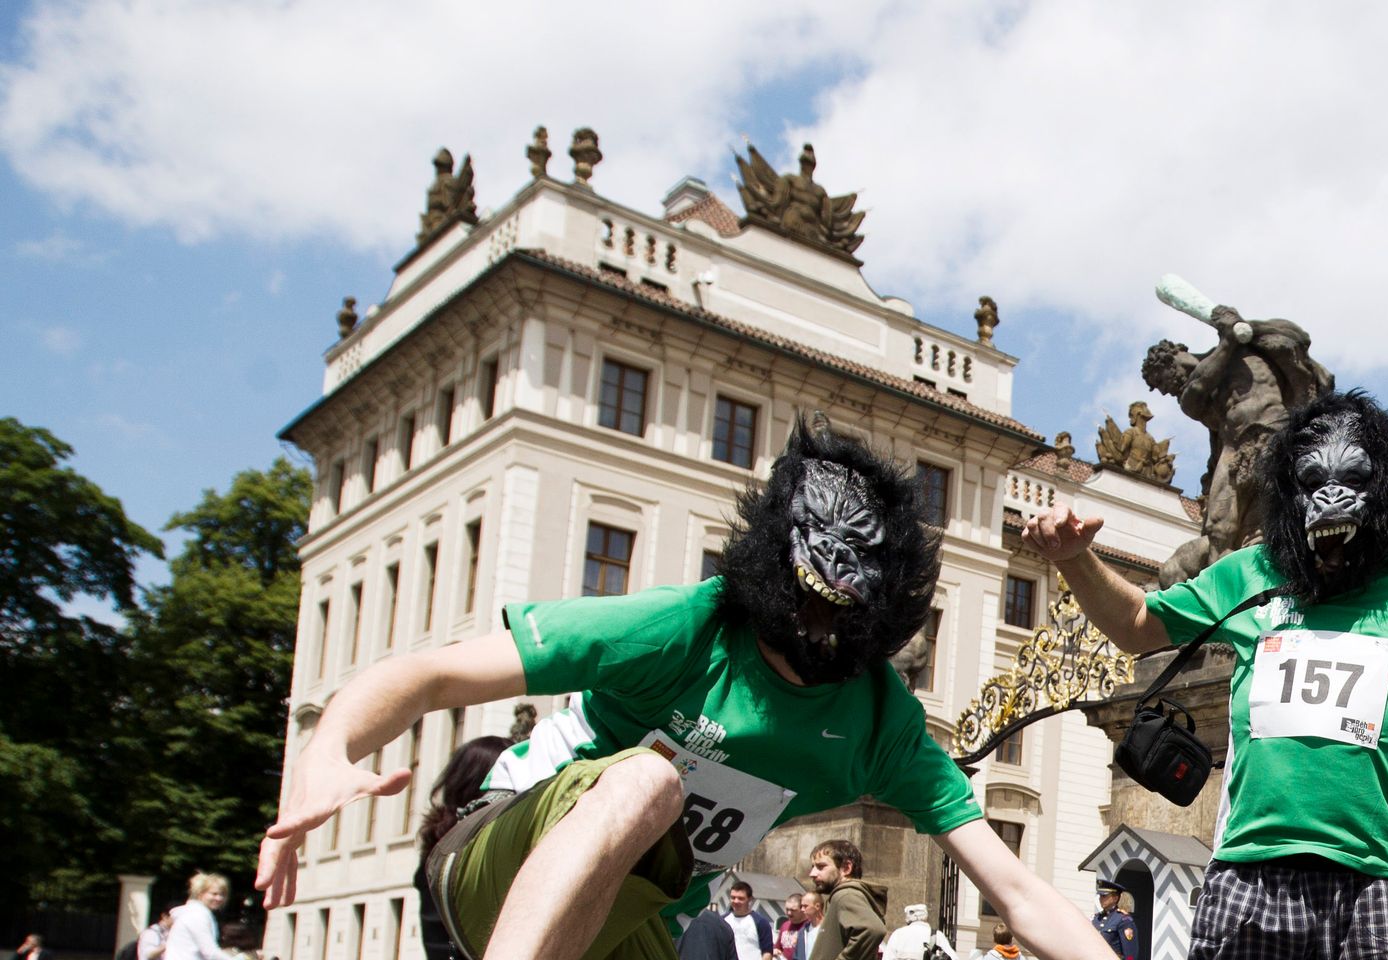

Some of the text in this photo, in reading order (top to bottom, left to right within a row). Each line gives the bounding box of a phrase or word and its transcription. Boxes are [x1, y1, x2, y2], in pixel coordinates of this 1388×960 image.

[1278, 658, 1365, 709] 157
[684, 729, 715, 749] pro
[696, 714, 727, 744] Běh
[683, 792, 745, 853] 58
